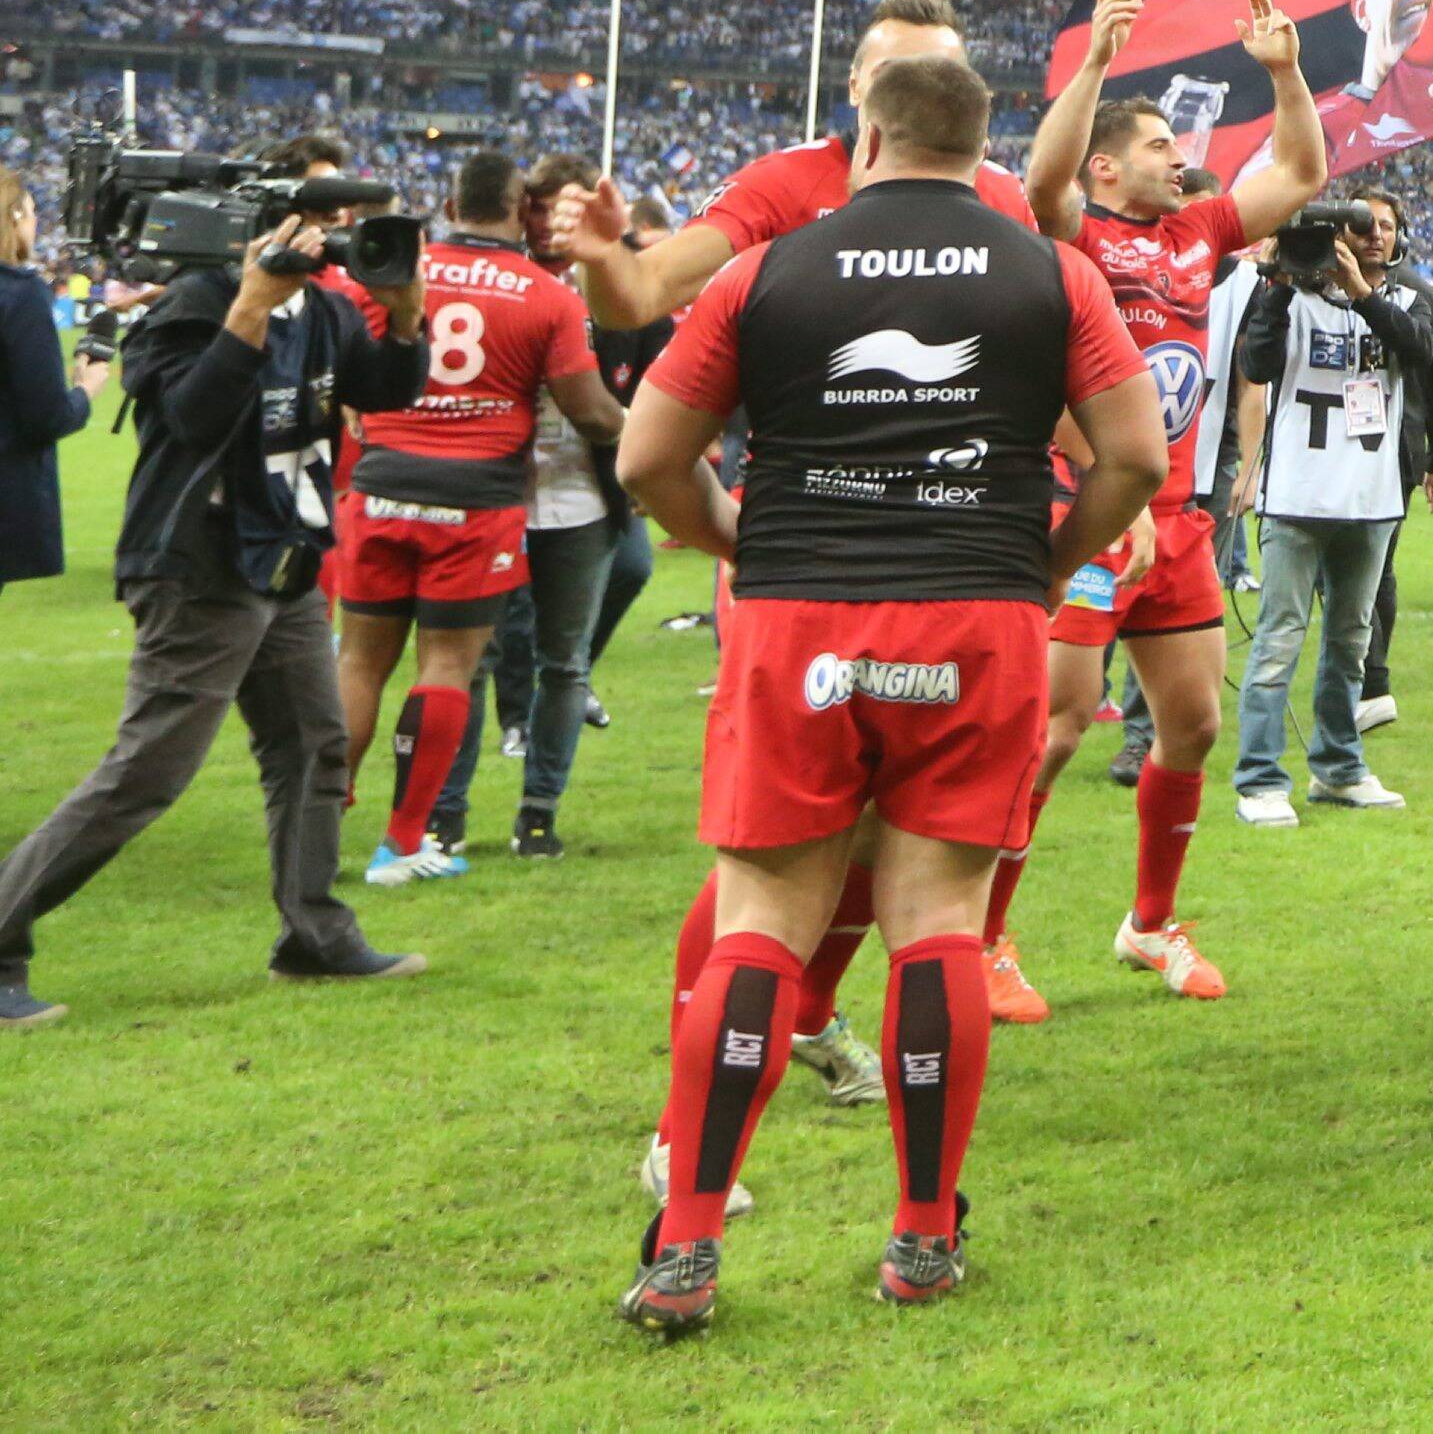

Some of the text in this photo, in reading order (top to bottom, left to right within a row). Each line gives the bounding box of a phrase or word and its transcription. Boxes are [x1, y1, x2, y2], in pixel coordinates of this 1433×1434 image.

[836, 247, 989, 278] TOULON
[1117, 306, 1168, 330] ULON
[430, 302, 486, 386] 8
[823, 387, 980, 404] BURRDA SPORT
[806, 654, 958, 706] ORANGINA
[723, 1028, 765, 1068] RCT
[904, 1052, 942, 1085] RCT
